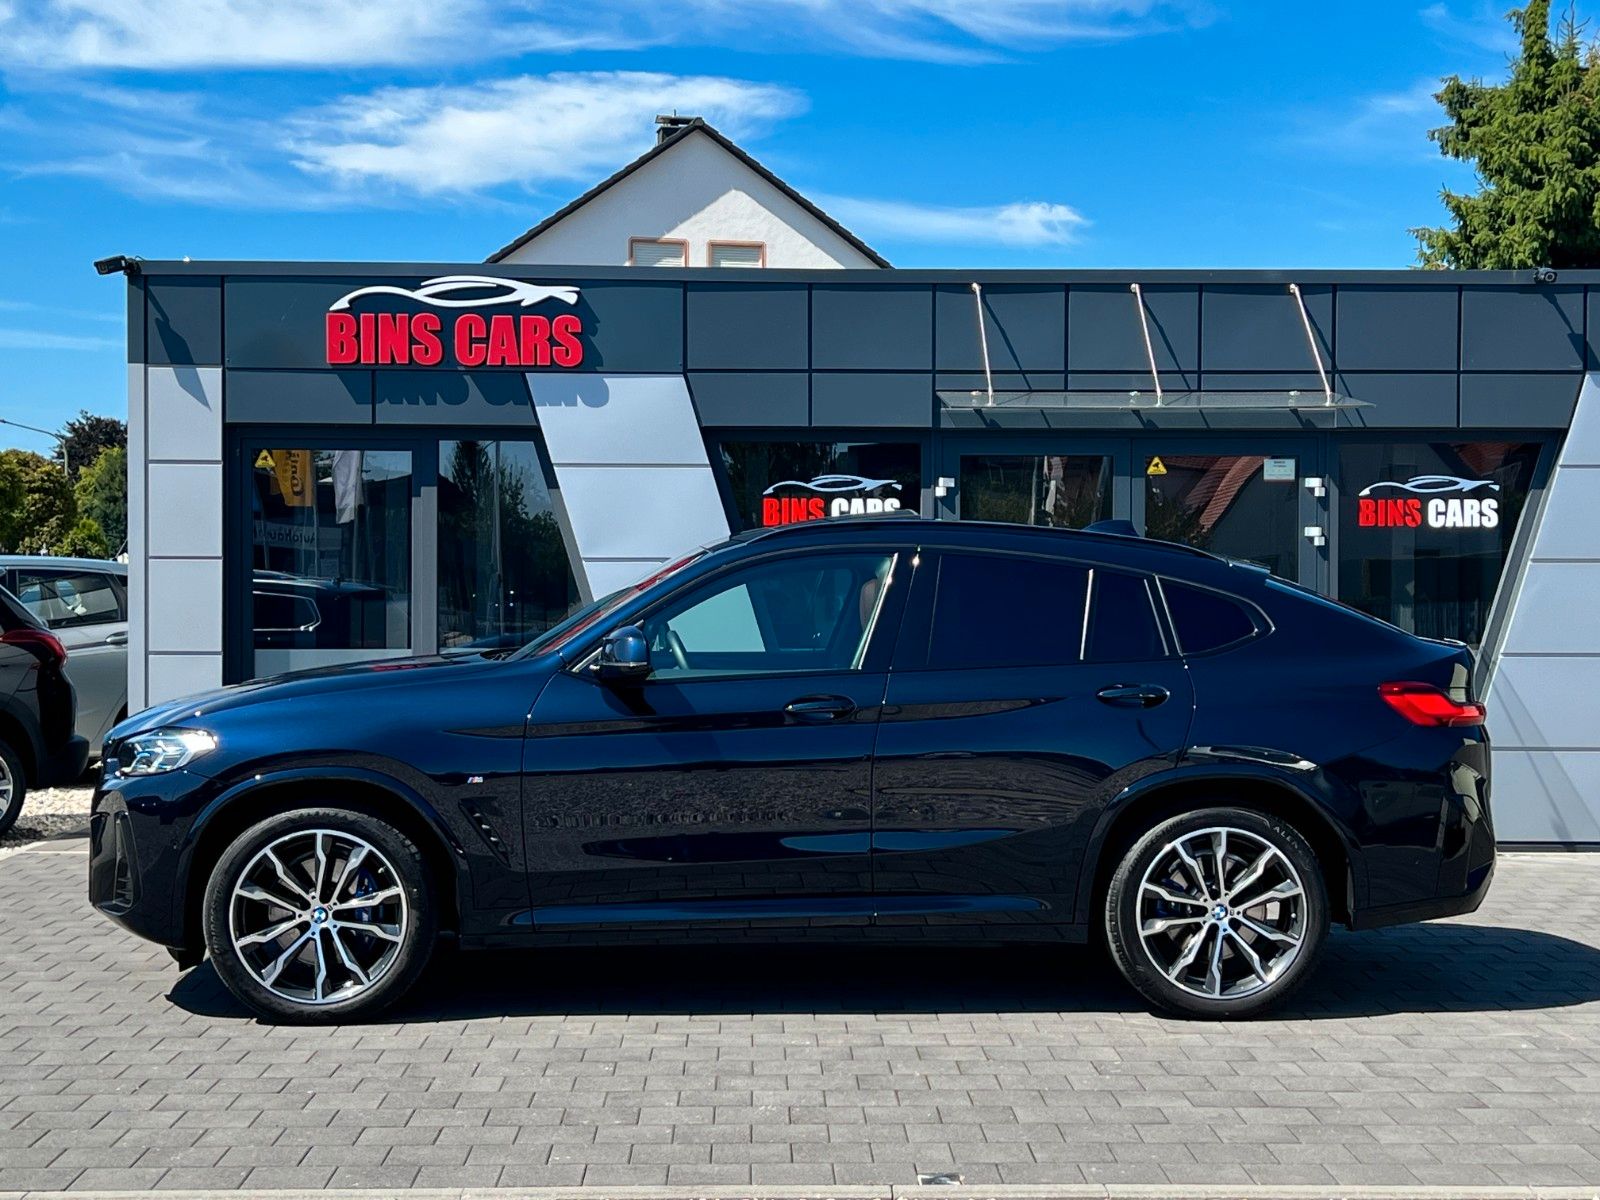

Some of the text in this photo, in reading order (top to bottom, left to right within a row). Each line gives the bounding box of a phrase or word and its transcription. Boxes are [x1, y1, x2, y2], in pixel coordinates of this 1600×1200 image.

[325, 312, 584, 367] BINS CARS
[763, 497, 825, 527] BINS
[1358, 498, 1499, 529] BINS CARS
